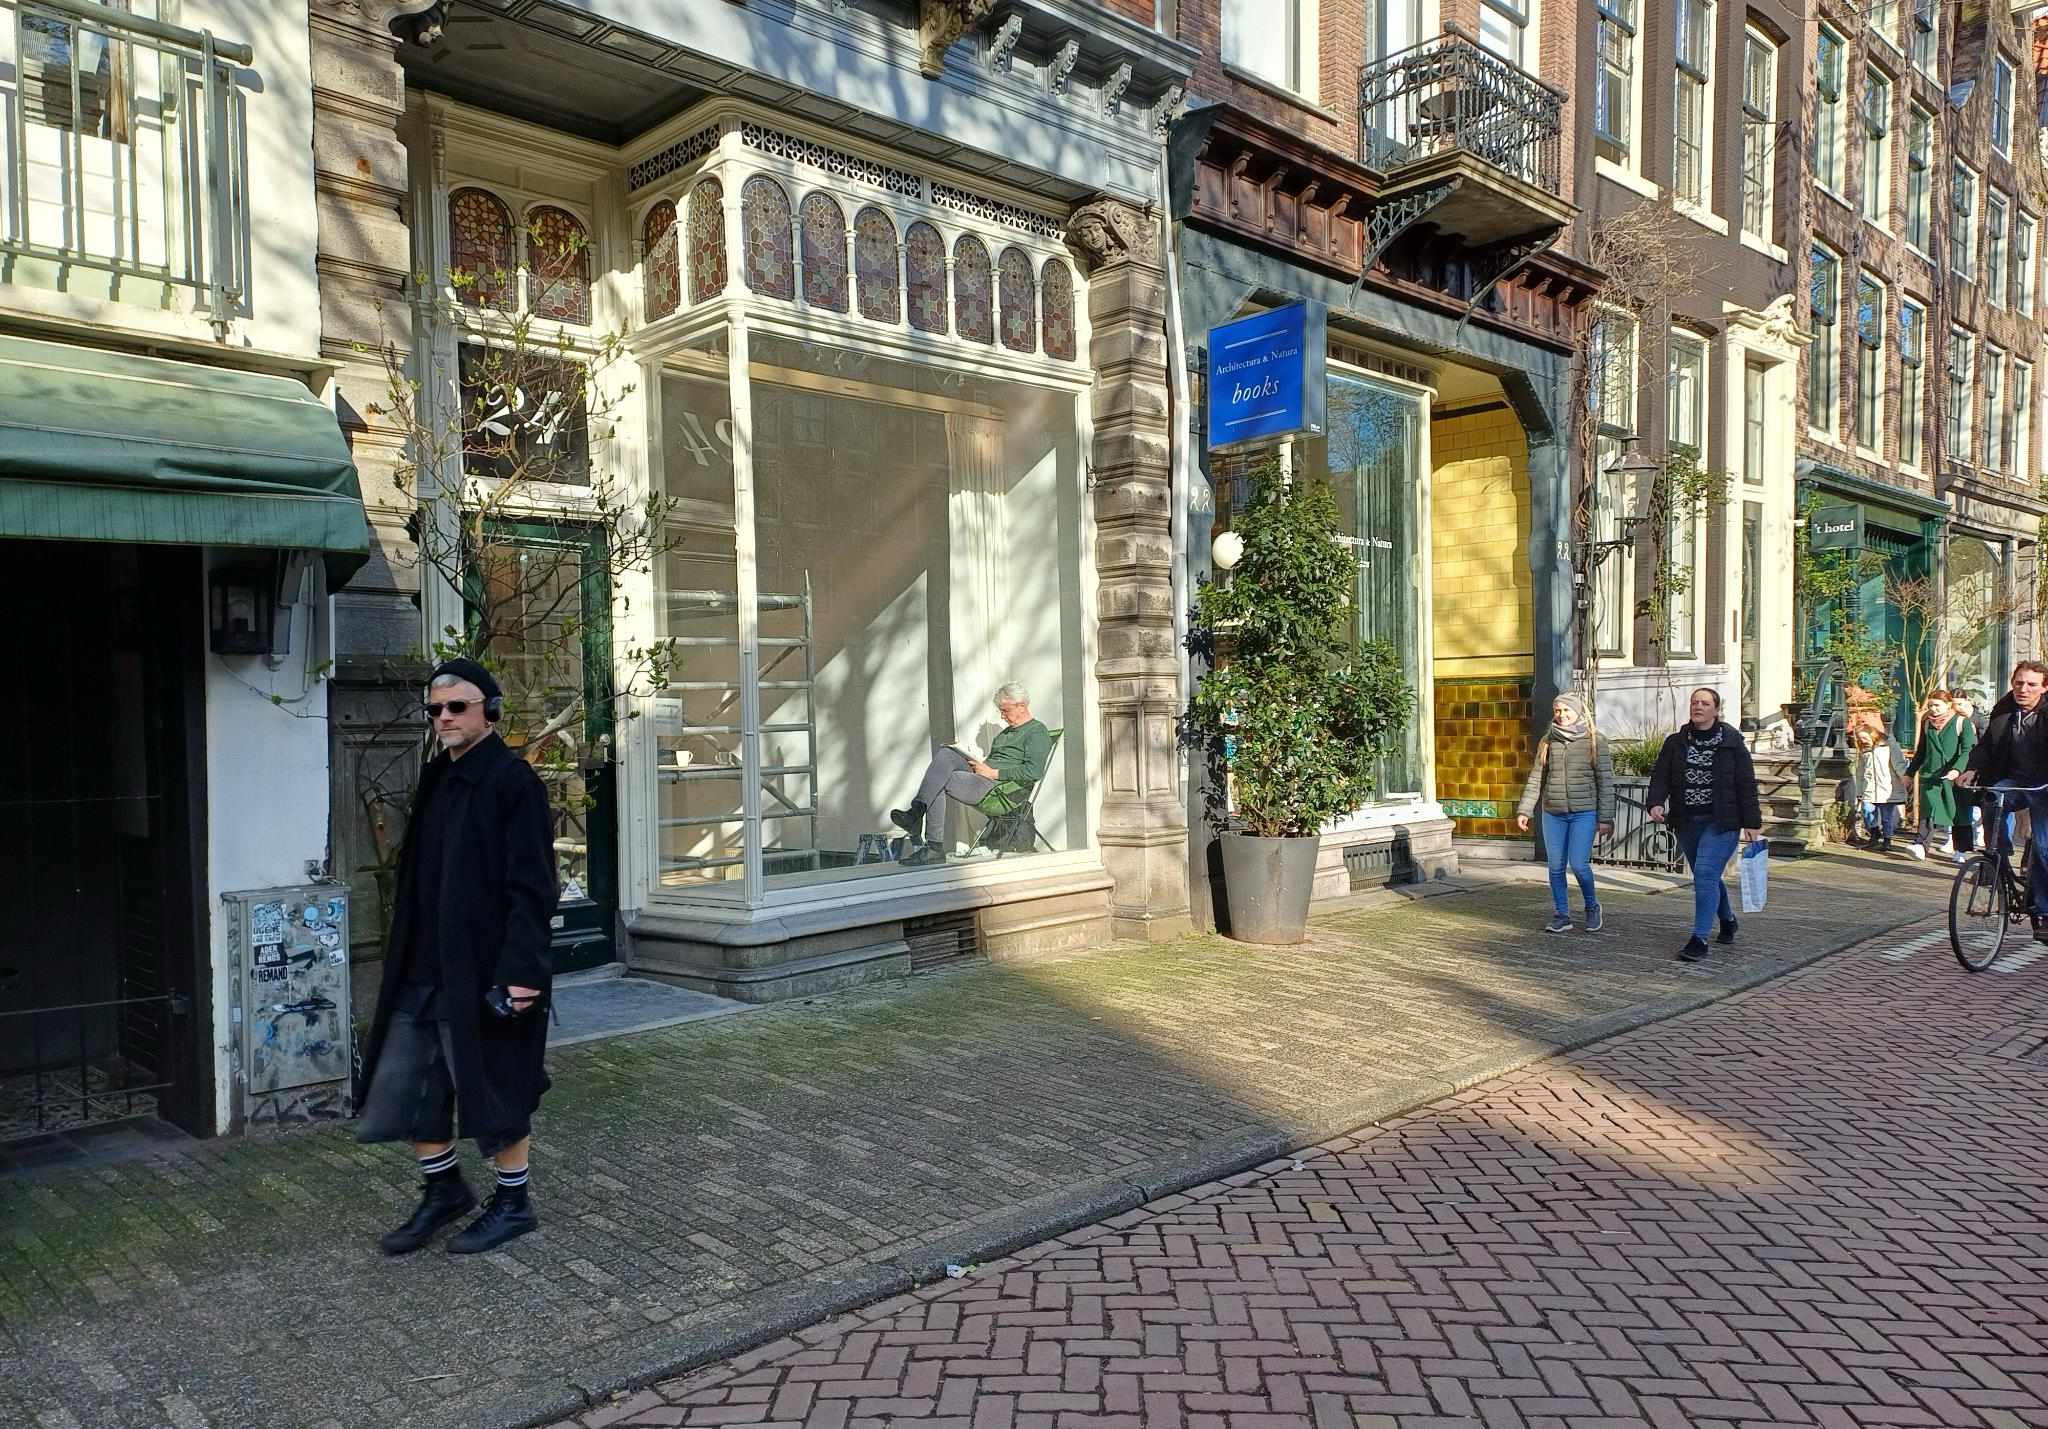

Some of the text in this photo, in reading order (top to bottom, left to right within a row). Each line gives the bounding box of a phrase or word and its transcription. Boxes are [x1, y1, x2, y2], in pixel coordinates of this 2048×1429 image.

[1216, 347, 1298, 376] Architectura & Natura
[1232, 375, 1280, 405] books
[477, 383, 565, 444] 24
[1190, 486, 1211, 512] 22
[1824, 519, 1855, 534] hotel
[1372, 536, 1393, 549] Natura
